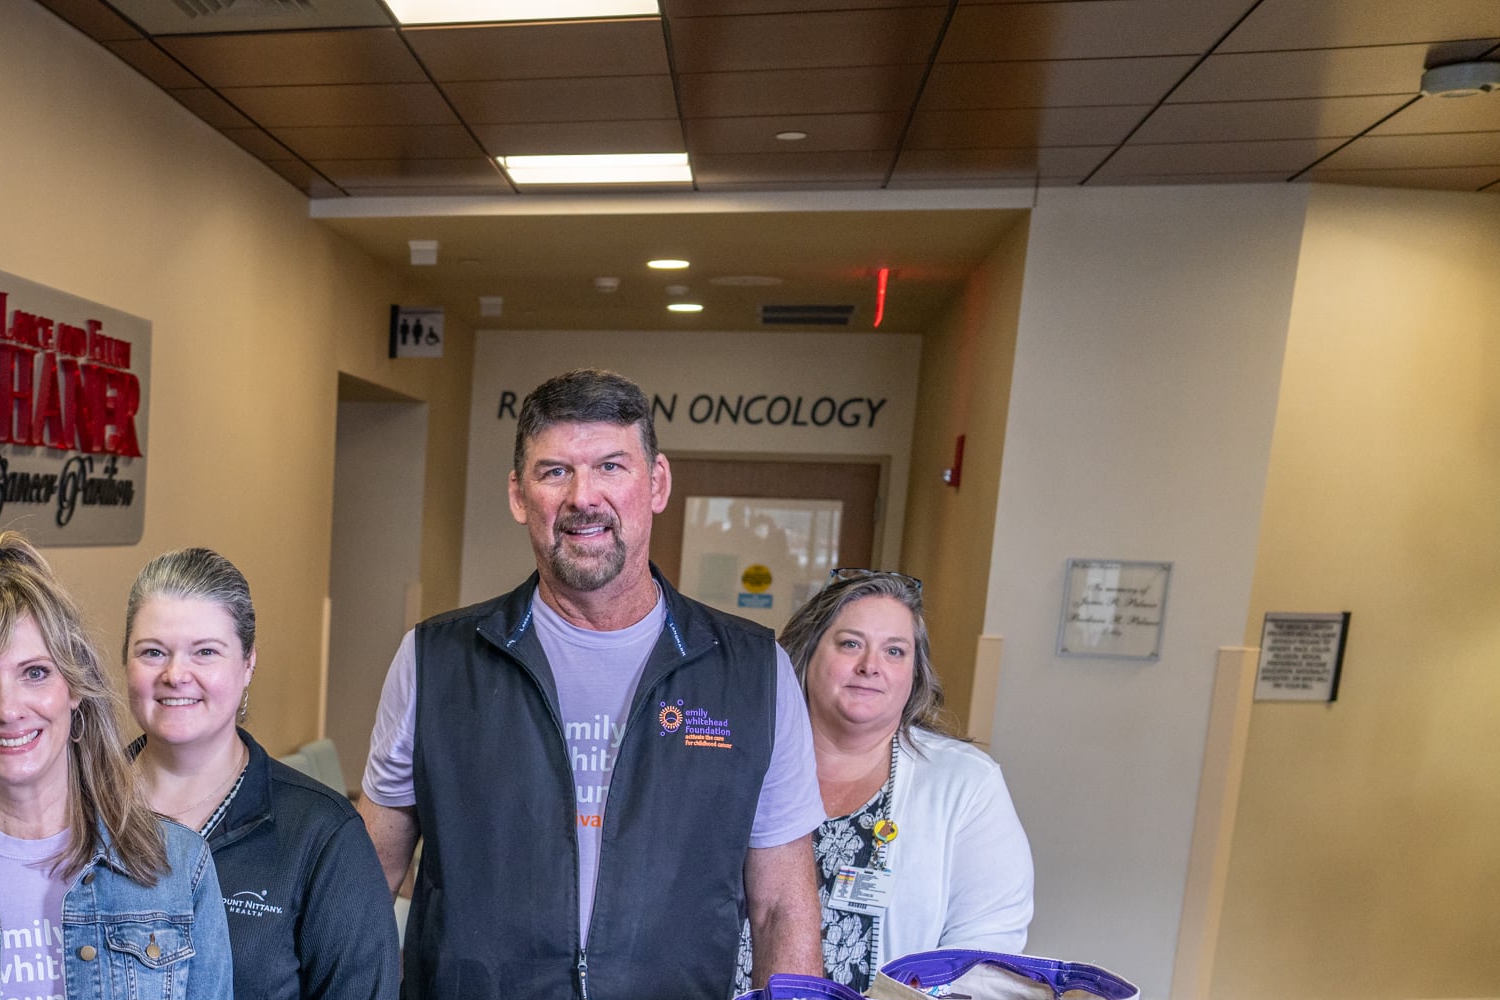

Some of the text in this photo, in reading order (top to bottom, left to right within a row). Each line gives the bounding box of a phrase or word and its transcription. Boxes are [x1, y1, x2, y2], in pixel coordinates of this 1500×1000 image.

[689, 393, 887, 429] ONCOLOGY
[685, 708, 708, 719] emily
[685, 717, 728, 727] whitehead
[565, 714, 627, 748] mily
[222, 897, 283, 914] OUNT NITTANY
[229, 906, 264, 917] HEALTH
[3, 918, 64, 954] mily
